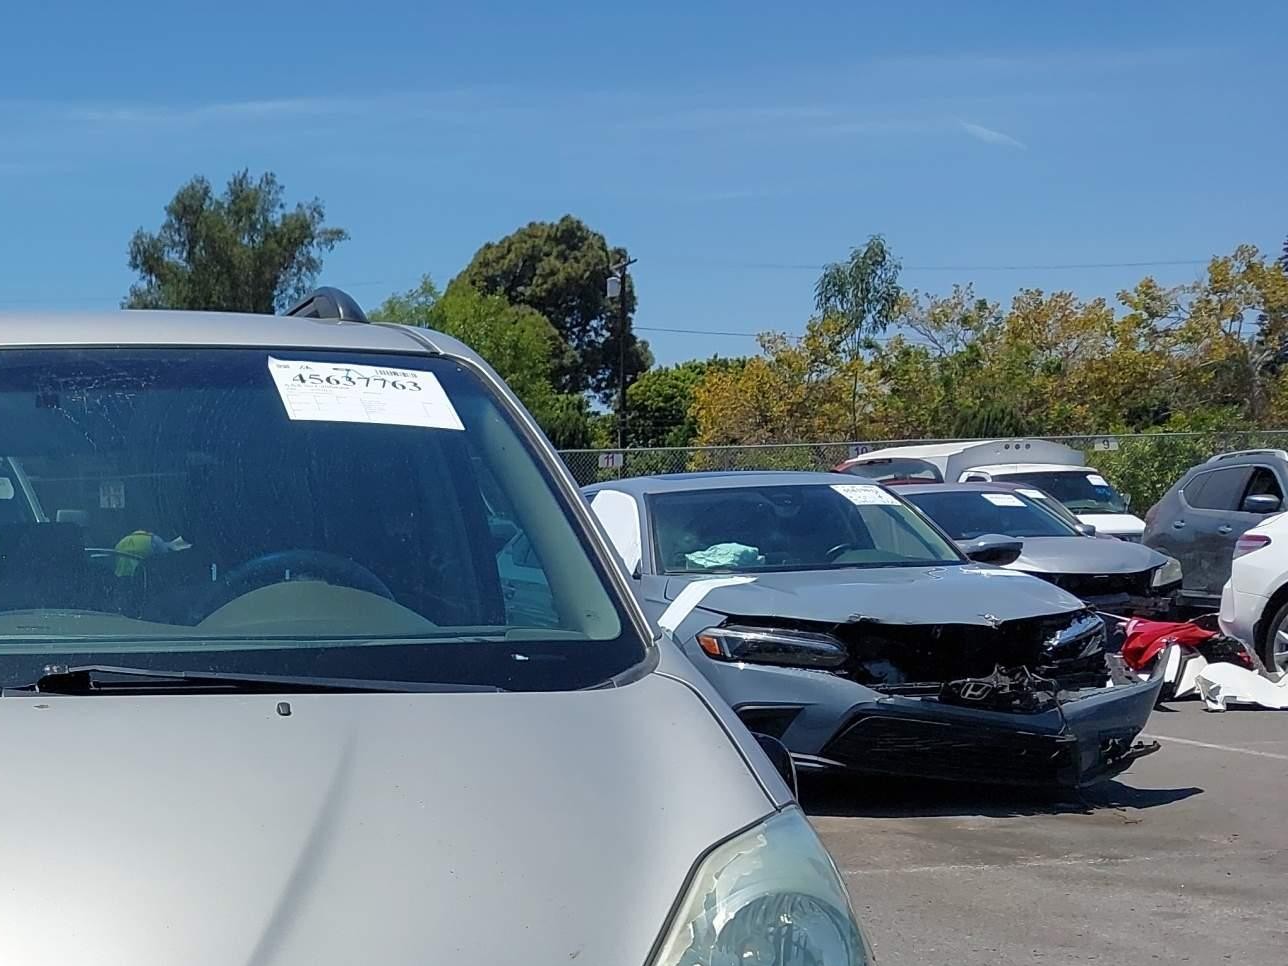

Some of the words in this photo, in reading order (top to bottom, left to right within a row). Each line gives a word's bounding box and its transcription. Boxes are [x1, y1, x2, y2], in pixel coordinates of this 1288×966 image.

[292, 373, 423, 392] 45637763
[1102, 439, 1110, 450] 9
[604, 454, 615, 466] 11
